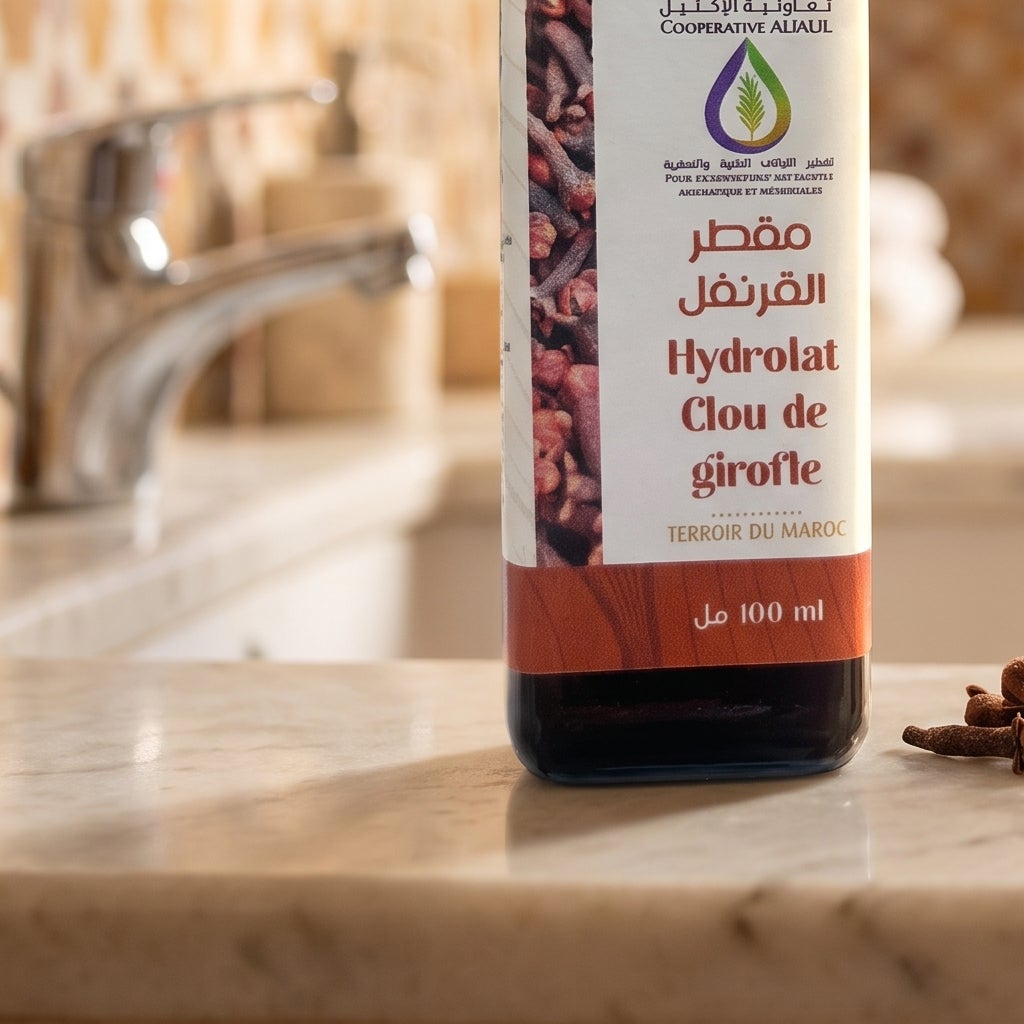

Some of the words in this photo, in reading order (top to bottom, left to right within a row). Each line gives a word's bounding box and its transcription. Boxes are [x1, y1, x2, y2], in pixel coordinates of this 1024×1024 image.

[660, 19, 766, 34] COOPERATIVE
[688, 215, 812, 264] مقطر
[678, 270, 826, 318] القرنفل
[668, 335, 840, 384] Hydrolat
[681, 395, 767, 432] Clou
[782, 392, 828, 429] de
[667, 523, 743, 543] TERROIR
[749, 522, 775, 540] DU
[780, 519, 847, 539] MAROC
[693, 602, 729, 630] مل
[740, 600, 783, 624] 100
[794, 598, 824, 622] ml
